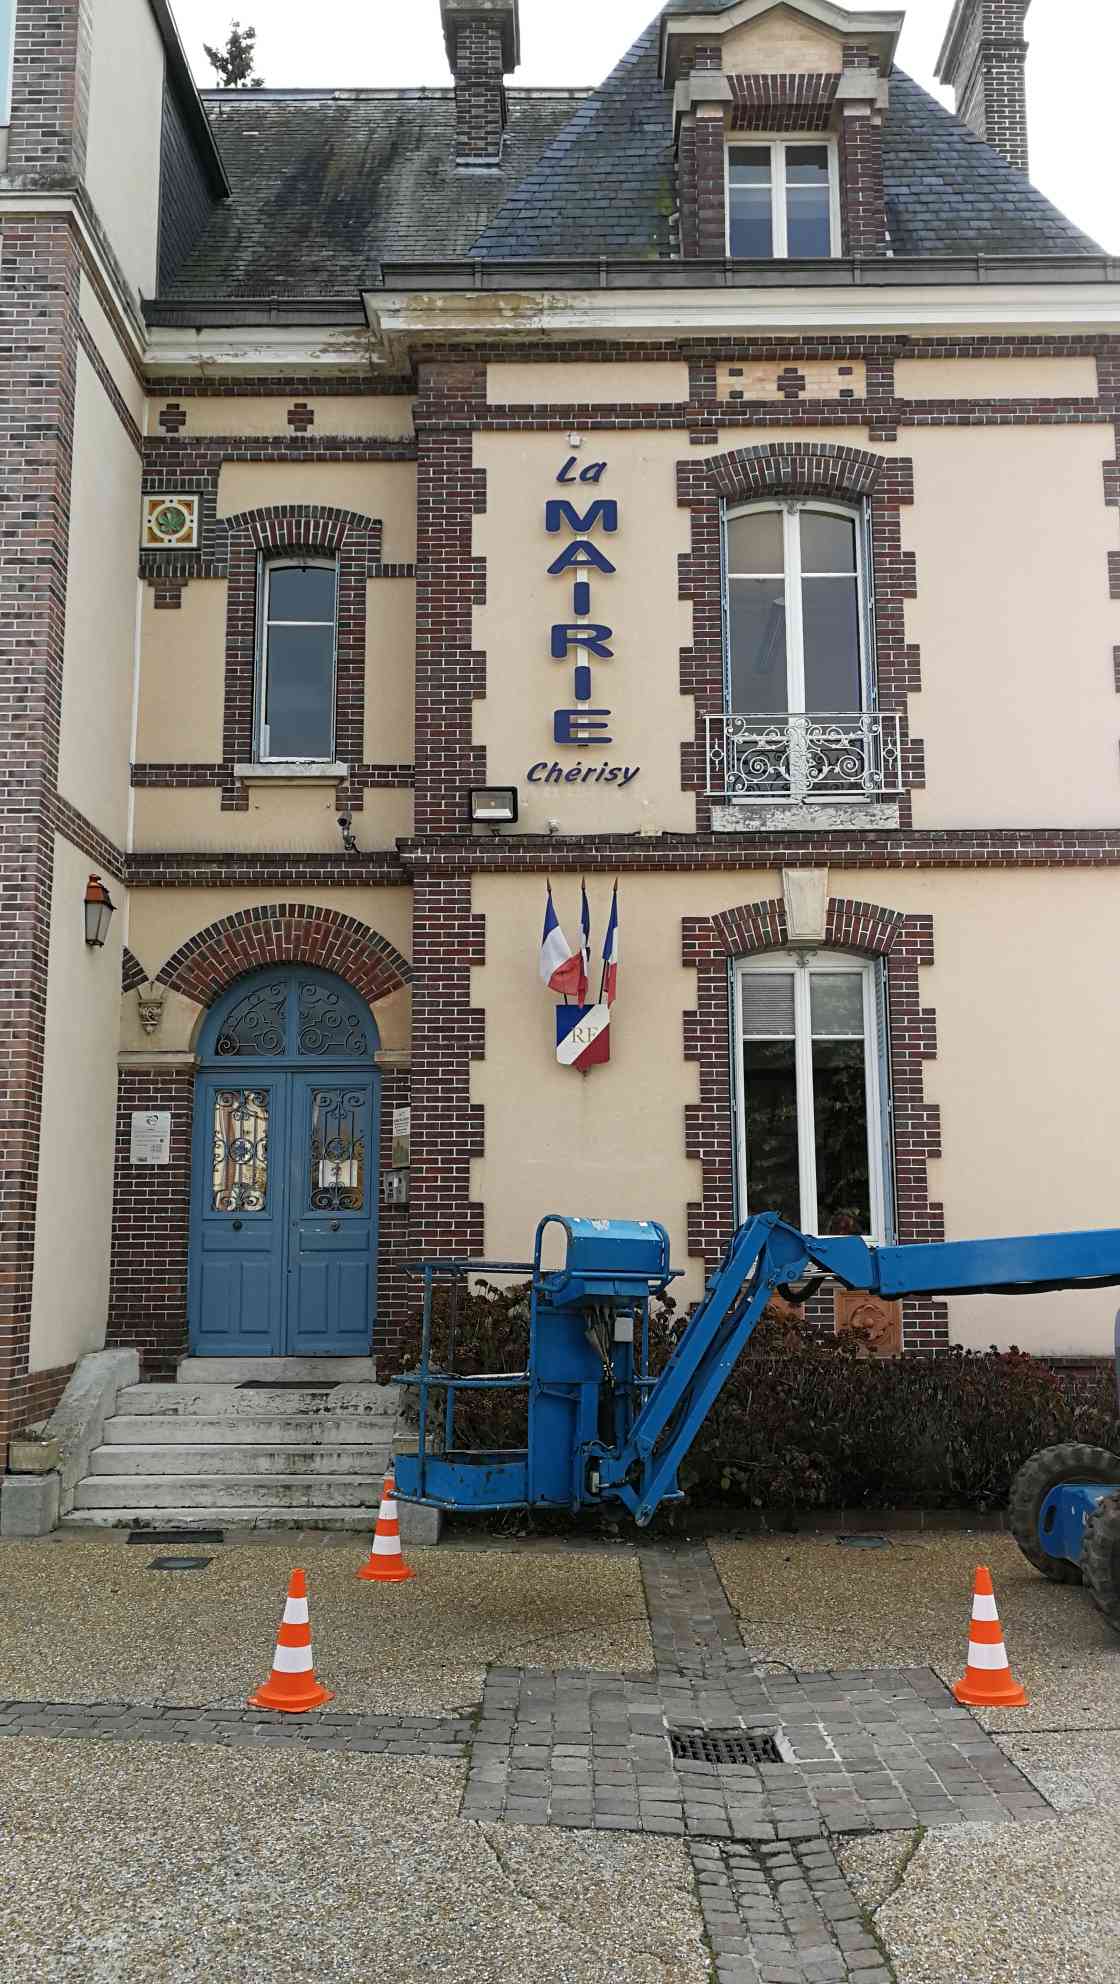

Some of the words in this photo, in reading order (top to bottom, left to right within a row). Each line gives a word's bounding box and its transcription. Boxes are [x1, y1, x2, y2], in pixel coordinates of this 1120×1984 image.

[556, 456, 608, 484] La
[545, 499, 619, 744] MAIRIE
[526, 761, 640, 787] Chérisy
[571, 1027, 599, 1043] RF
